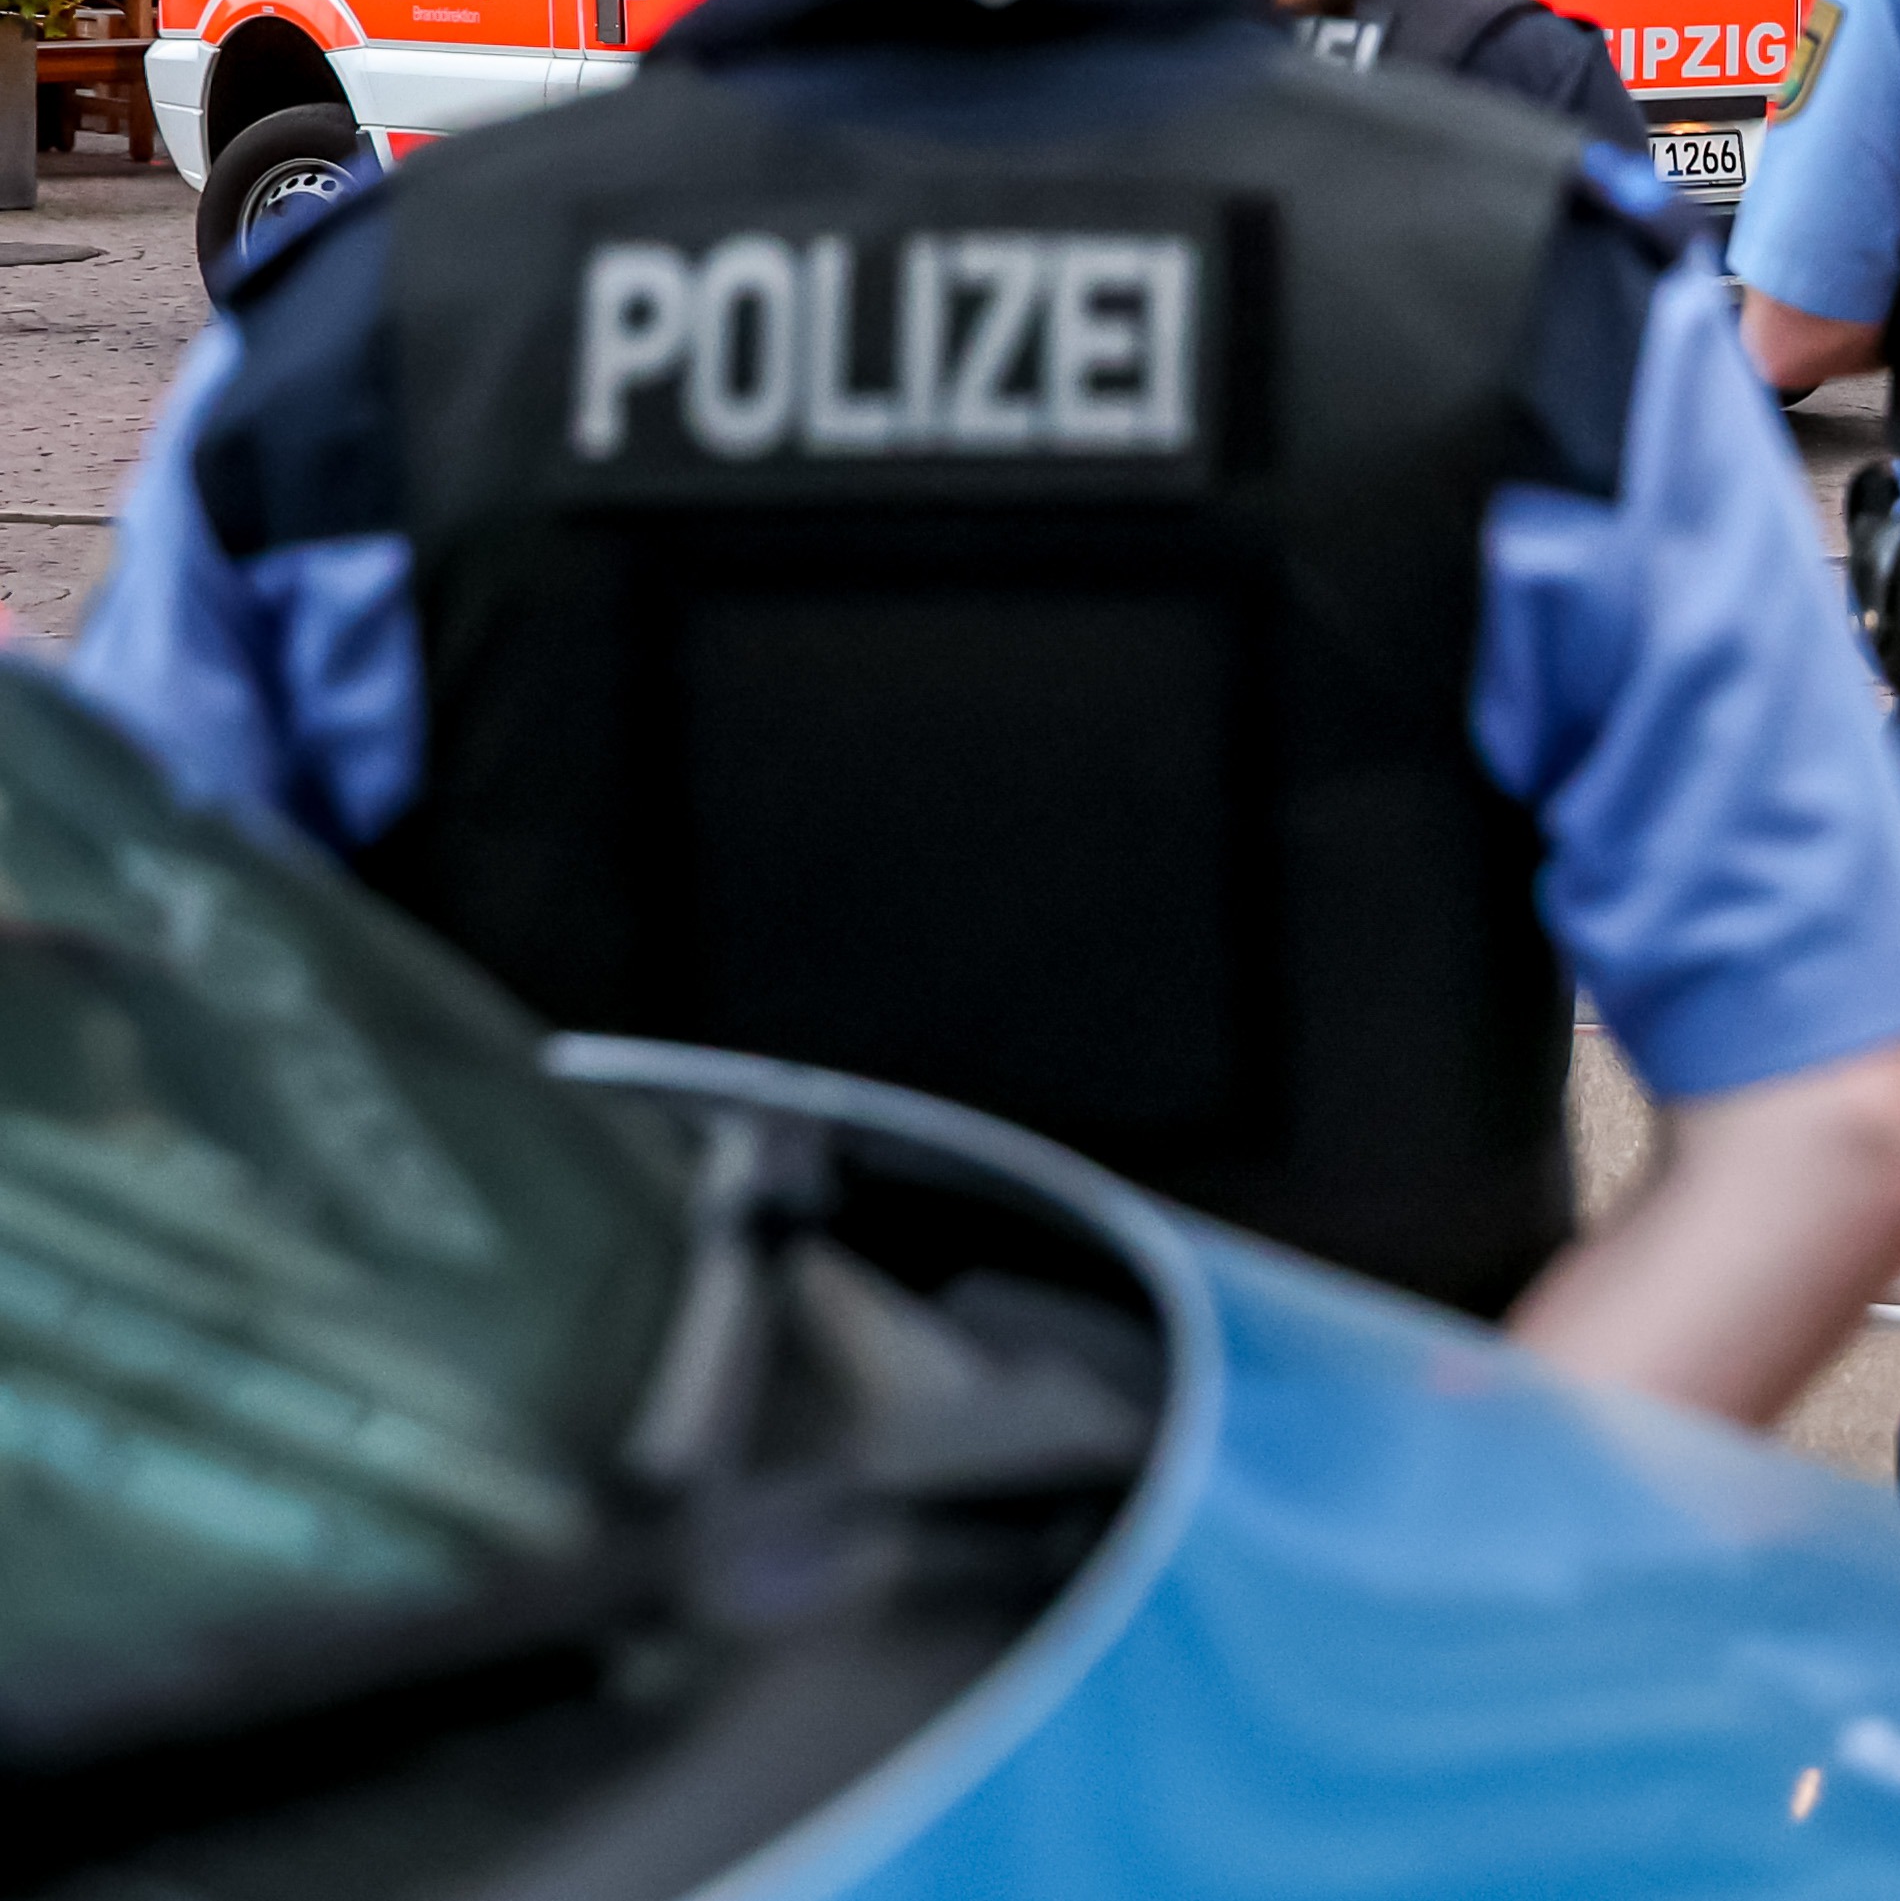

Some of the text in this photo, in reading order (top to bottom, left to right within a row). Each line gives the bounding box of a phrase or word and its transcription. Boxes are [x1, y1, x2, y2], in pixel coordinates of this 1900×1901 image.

[413, 5, 480, 24] Branddirektion
[1603, 21, 1786, 80] IPZIG
[1665, 140, 1737, 176] 1266
[570, 232, 1202, 463] POLIZEI
